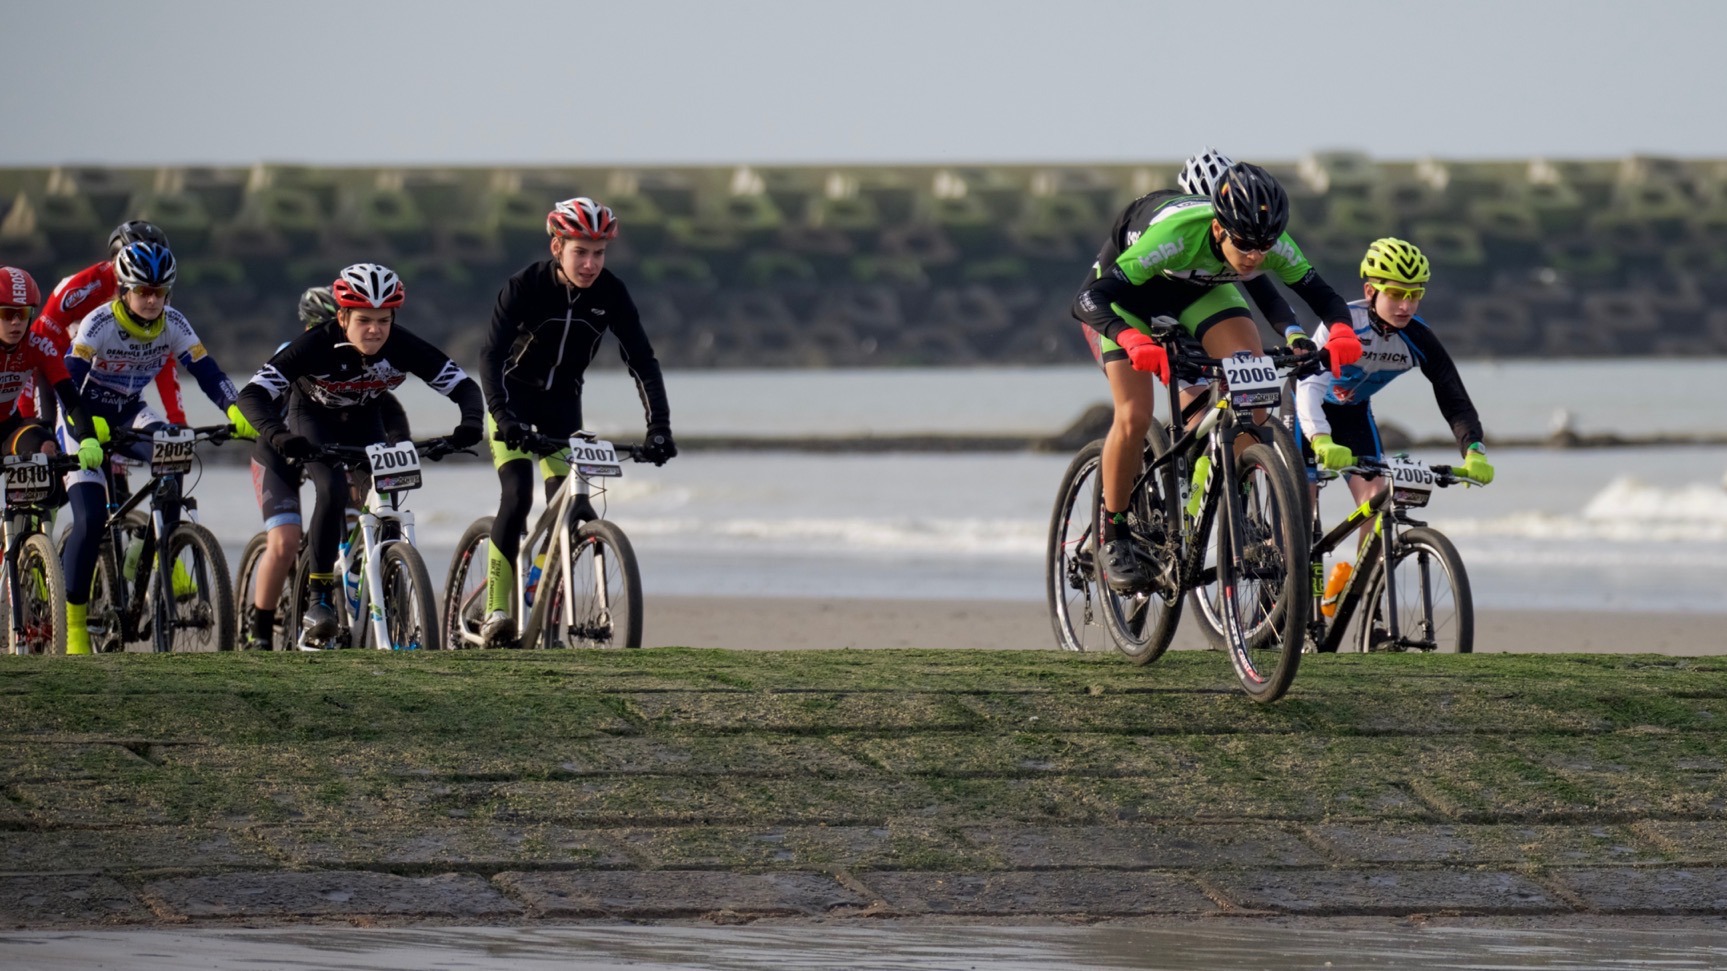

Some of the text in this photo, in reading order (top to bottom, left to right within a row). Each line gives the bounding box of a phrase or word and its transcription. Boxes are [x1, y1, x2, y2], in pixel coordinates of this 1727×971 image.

[1228, 367, 1276, 384] 2006
[155, 442, 193, 458] 2003
[574, 447, 615, 462] 2007
[371, 450, 417, 470] 2001
[6, 466, 47, 483] 2010
[1393, 468, 1433, 484] 2005
